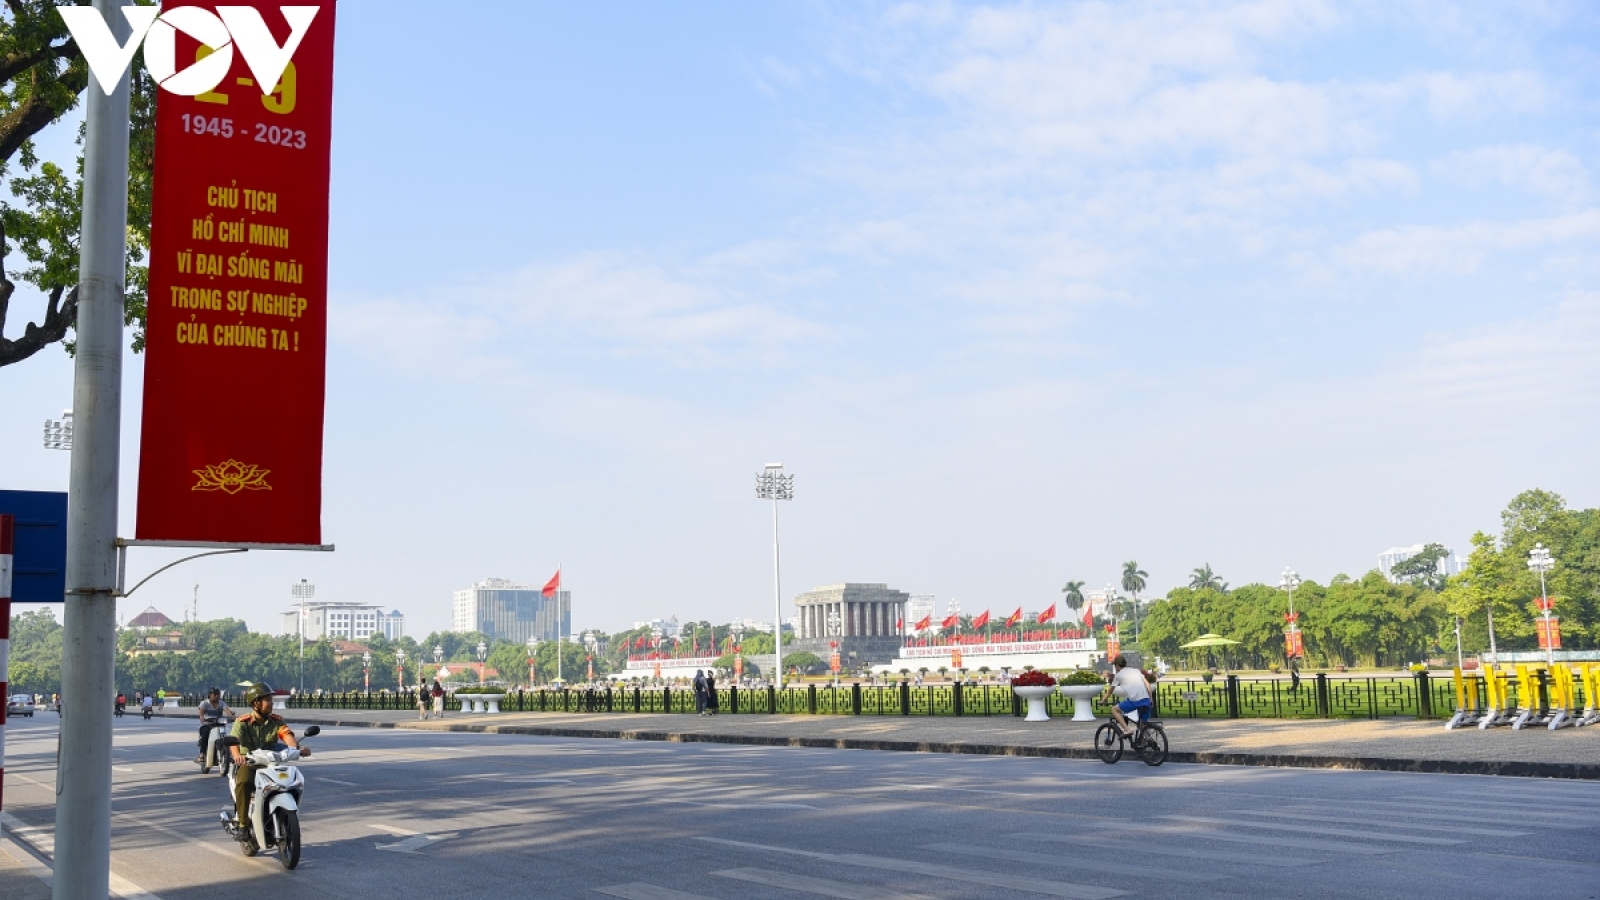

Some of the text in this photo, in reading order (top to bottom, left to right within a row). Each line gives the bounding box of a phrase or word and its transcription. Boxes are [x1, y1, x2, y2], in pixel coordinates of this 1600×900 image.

[181, 113, 234, 138] 1945
[254, 123, 306, 149] 2023
[207, 179, 277, 215] CHỦ TỊCH
[192, 213, 289, 249] HỒ CHÍ MINH
[177, 248, 303, 284] VĨ ĐẠI SỐNG MÃI
[170, 286, 308, 322] TRONG SỰ NGHIỆP
[176, 314, 209, 344] CỦA
[213, 320, 267, 349] CHÚNG
[271, 329, 289, 351] TA
